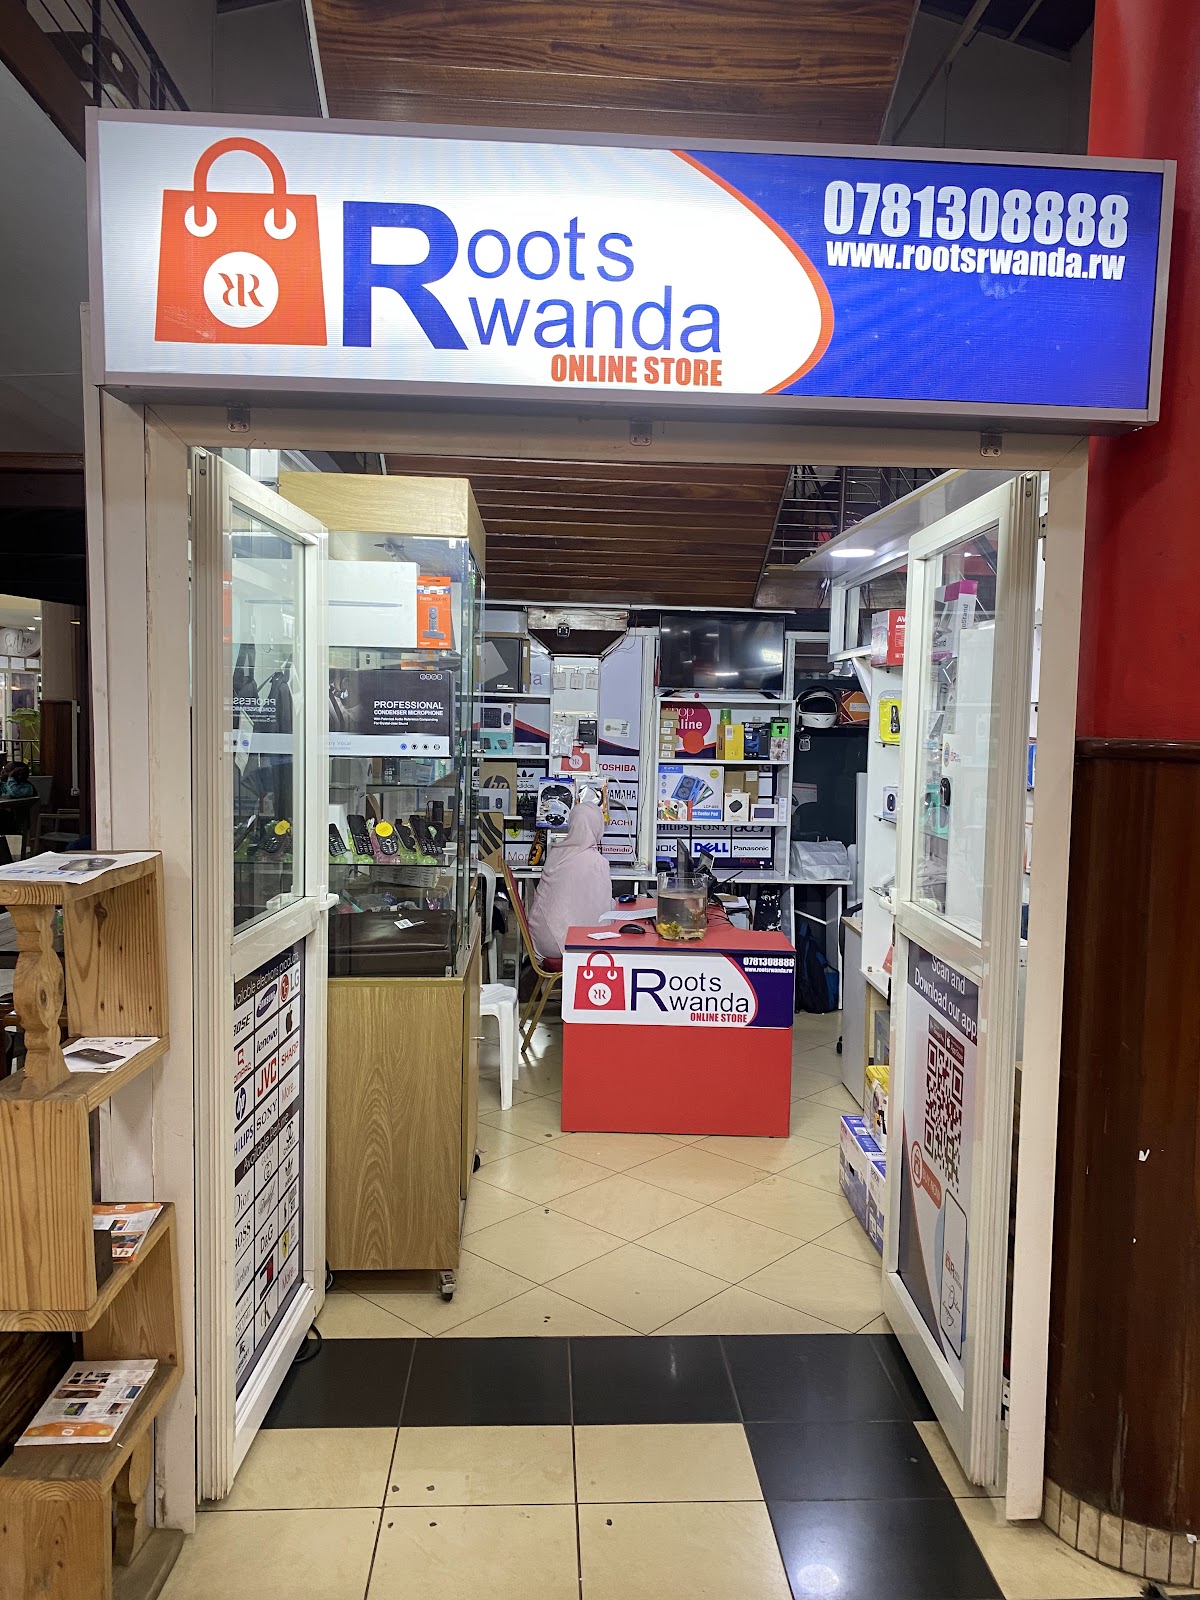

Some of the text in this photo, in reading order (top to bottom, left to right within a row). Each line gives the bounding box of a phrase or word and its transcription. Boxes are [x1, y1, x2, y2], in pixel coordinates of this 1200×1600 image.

[823, 181, 1130, 248] 0781308888
[826, 240, 1126, 280] www.rootsrwanda.rw
[551, 355, 723, 387] ONLINE STORE
[374, 701, 444, 709] PROFESSIONAL
[694, 843, 728, 852] DELL
[743, 956, 794, 966] 0781308888
[931, 955, 966, 996] Scan and
[291, 968, 300, 992] LG
[690, 1012, 748, 1023] ONLINE STORE
[914, 967, 978, 1041] Download our app
[257, 1057, 276, 1098] JVC
[256, 1098, 278, 1131] SONY
